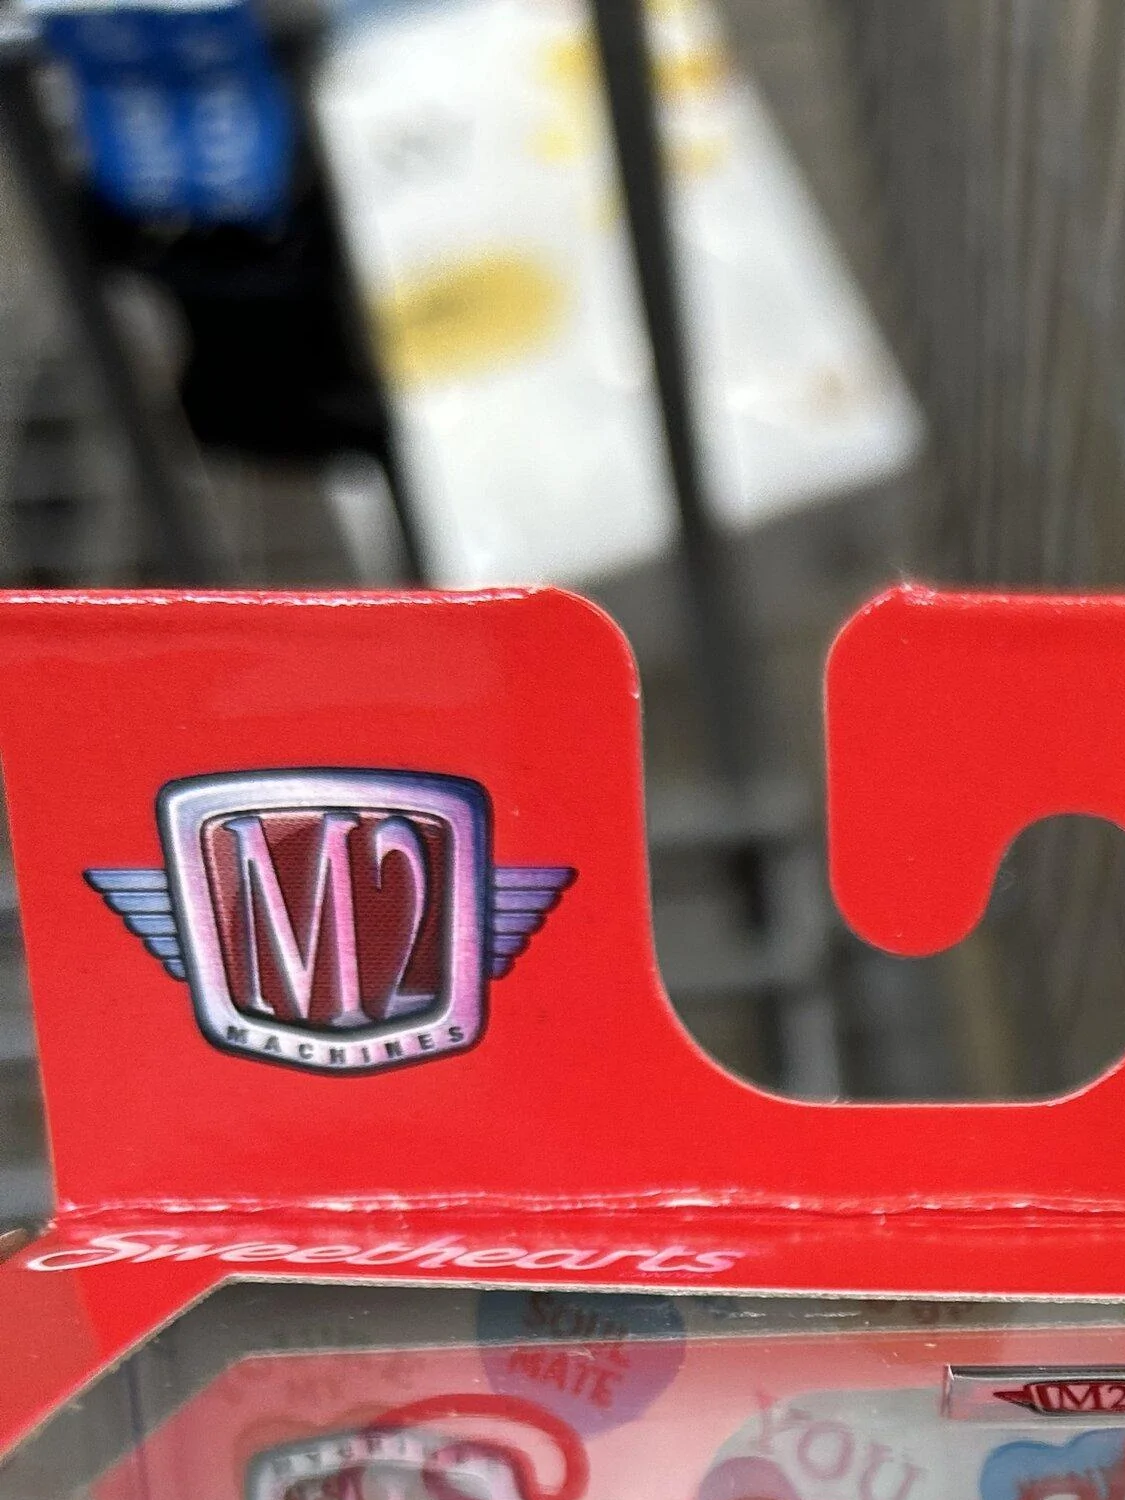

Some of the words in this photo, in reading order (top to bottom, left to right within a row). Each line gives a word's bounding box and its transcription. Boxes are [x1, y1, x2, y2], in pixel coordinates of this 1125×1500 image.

[224, 811, 437, 1027] M2
[226, 1024, 465, 1066] MACHINES
[25, 1229, 750, 1273] Sweethearts
